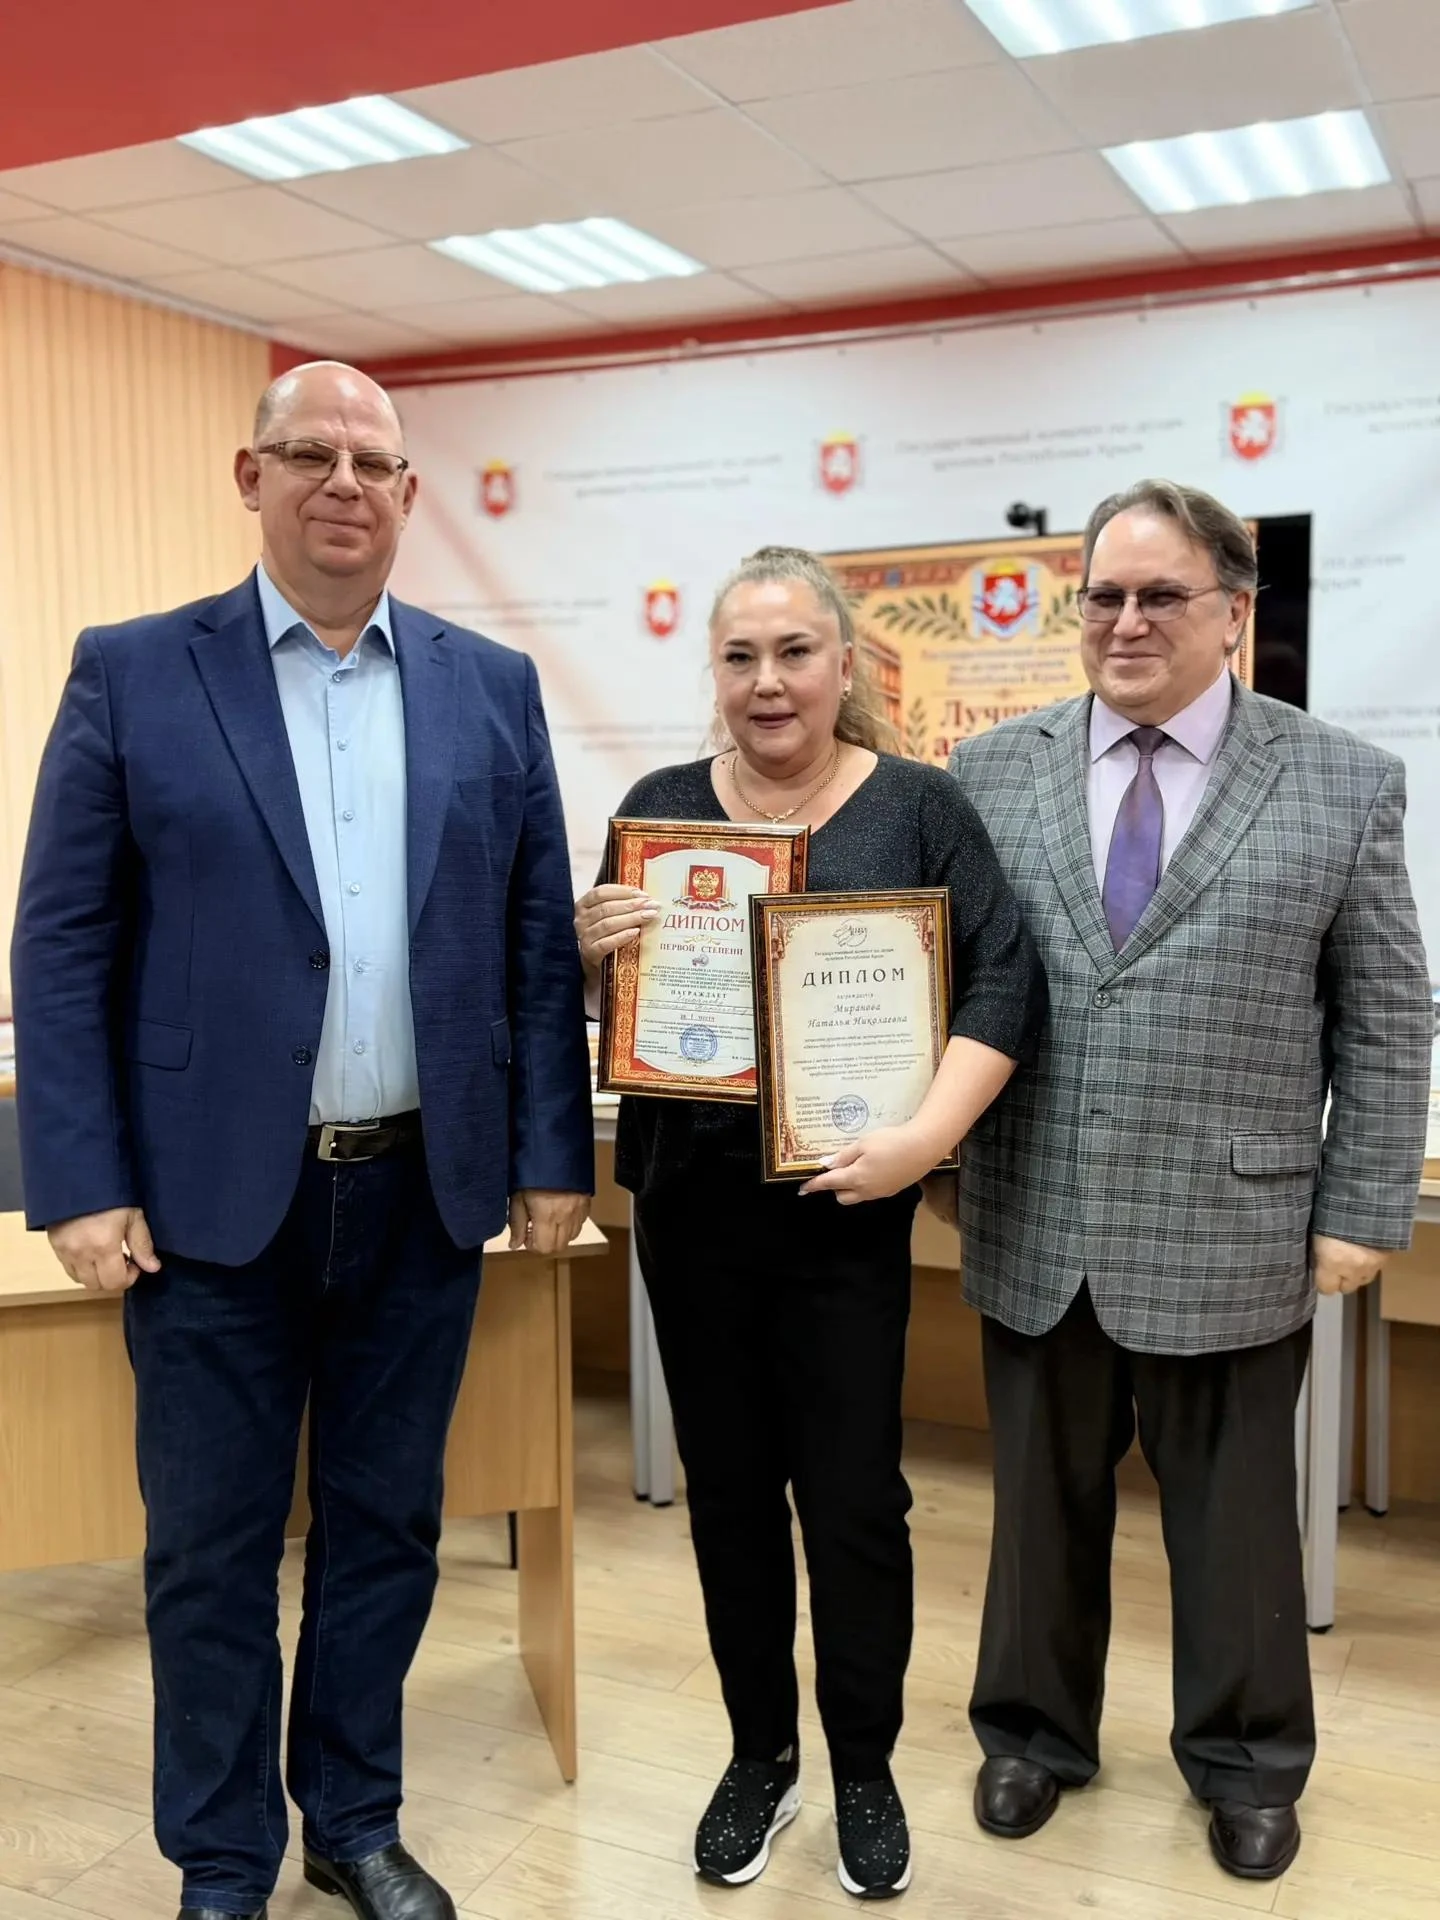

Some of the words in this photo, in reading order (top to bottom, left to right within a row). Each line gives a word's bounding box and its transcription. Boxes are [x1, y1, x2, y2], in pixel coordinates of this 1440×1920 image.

[662, 914, 745, 933] ДИПЛОМ
[660, 943, 695, 952] ПЕРВОЙ
[701, 945, 743, 956] СТЕПЕНИ
[801, 967, 905, 988] ДИПЛОМ
[670, 989, 727, 999] НАГРАЖДАЕТ
[852, 1015, 908, 1027] Николаевна
